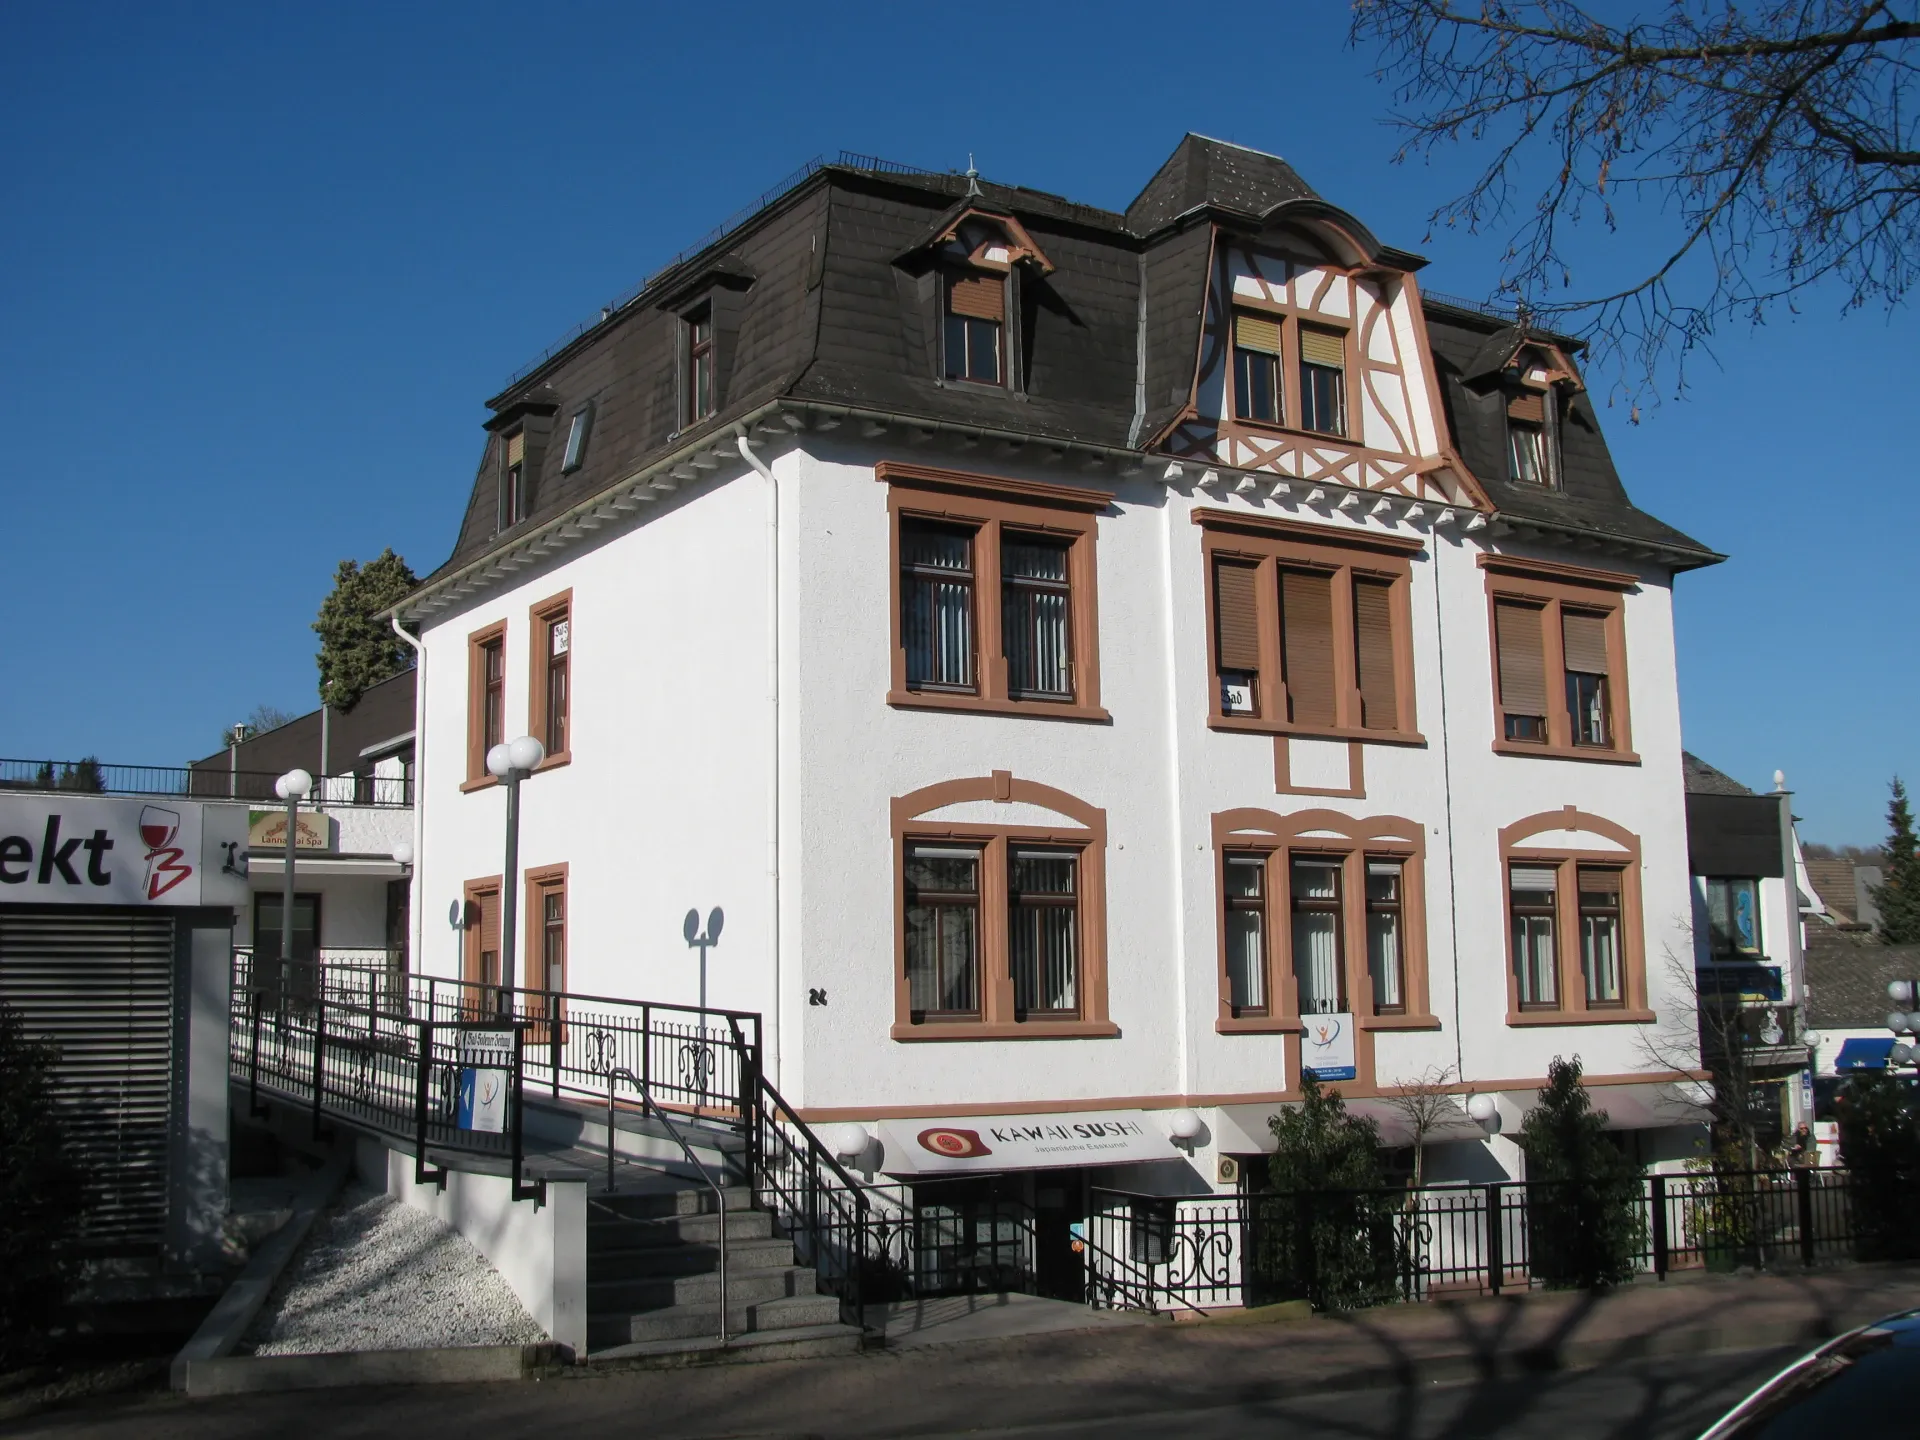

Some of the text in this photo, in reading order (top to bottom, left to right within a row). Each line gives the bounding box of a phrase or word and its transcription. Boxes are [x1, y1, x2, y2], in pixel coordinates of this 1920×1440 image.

[306, 838, 322, 847] Spa
[990, 1121, 1144, 1143] KAWAII SUSHI
[1035, 1141, 1128, 1153] Japanische Esskunst
